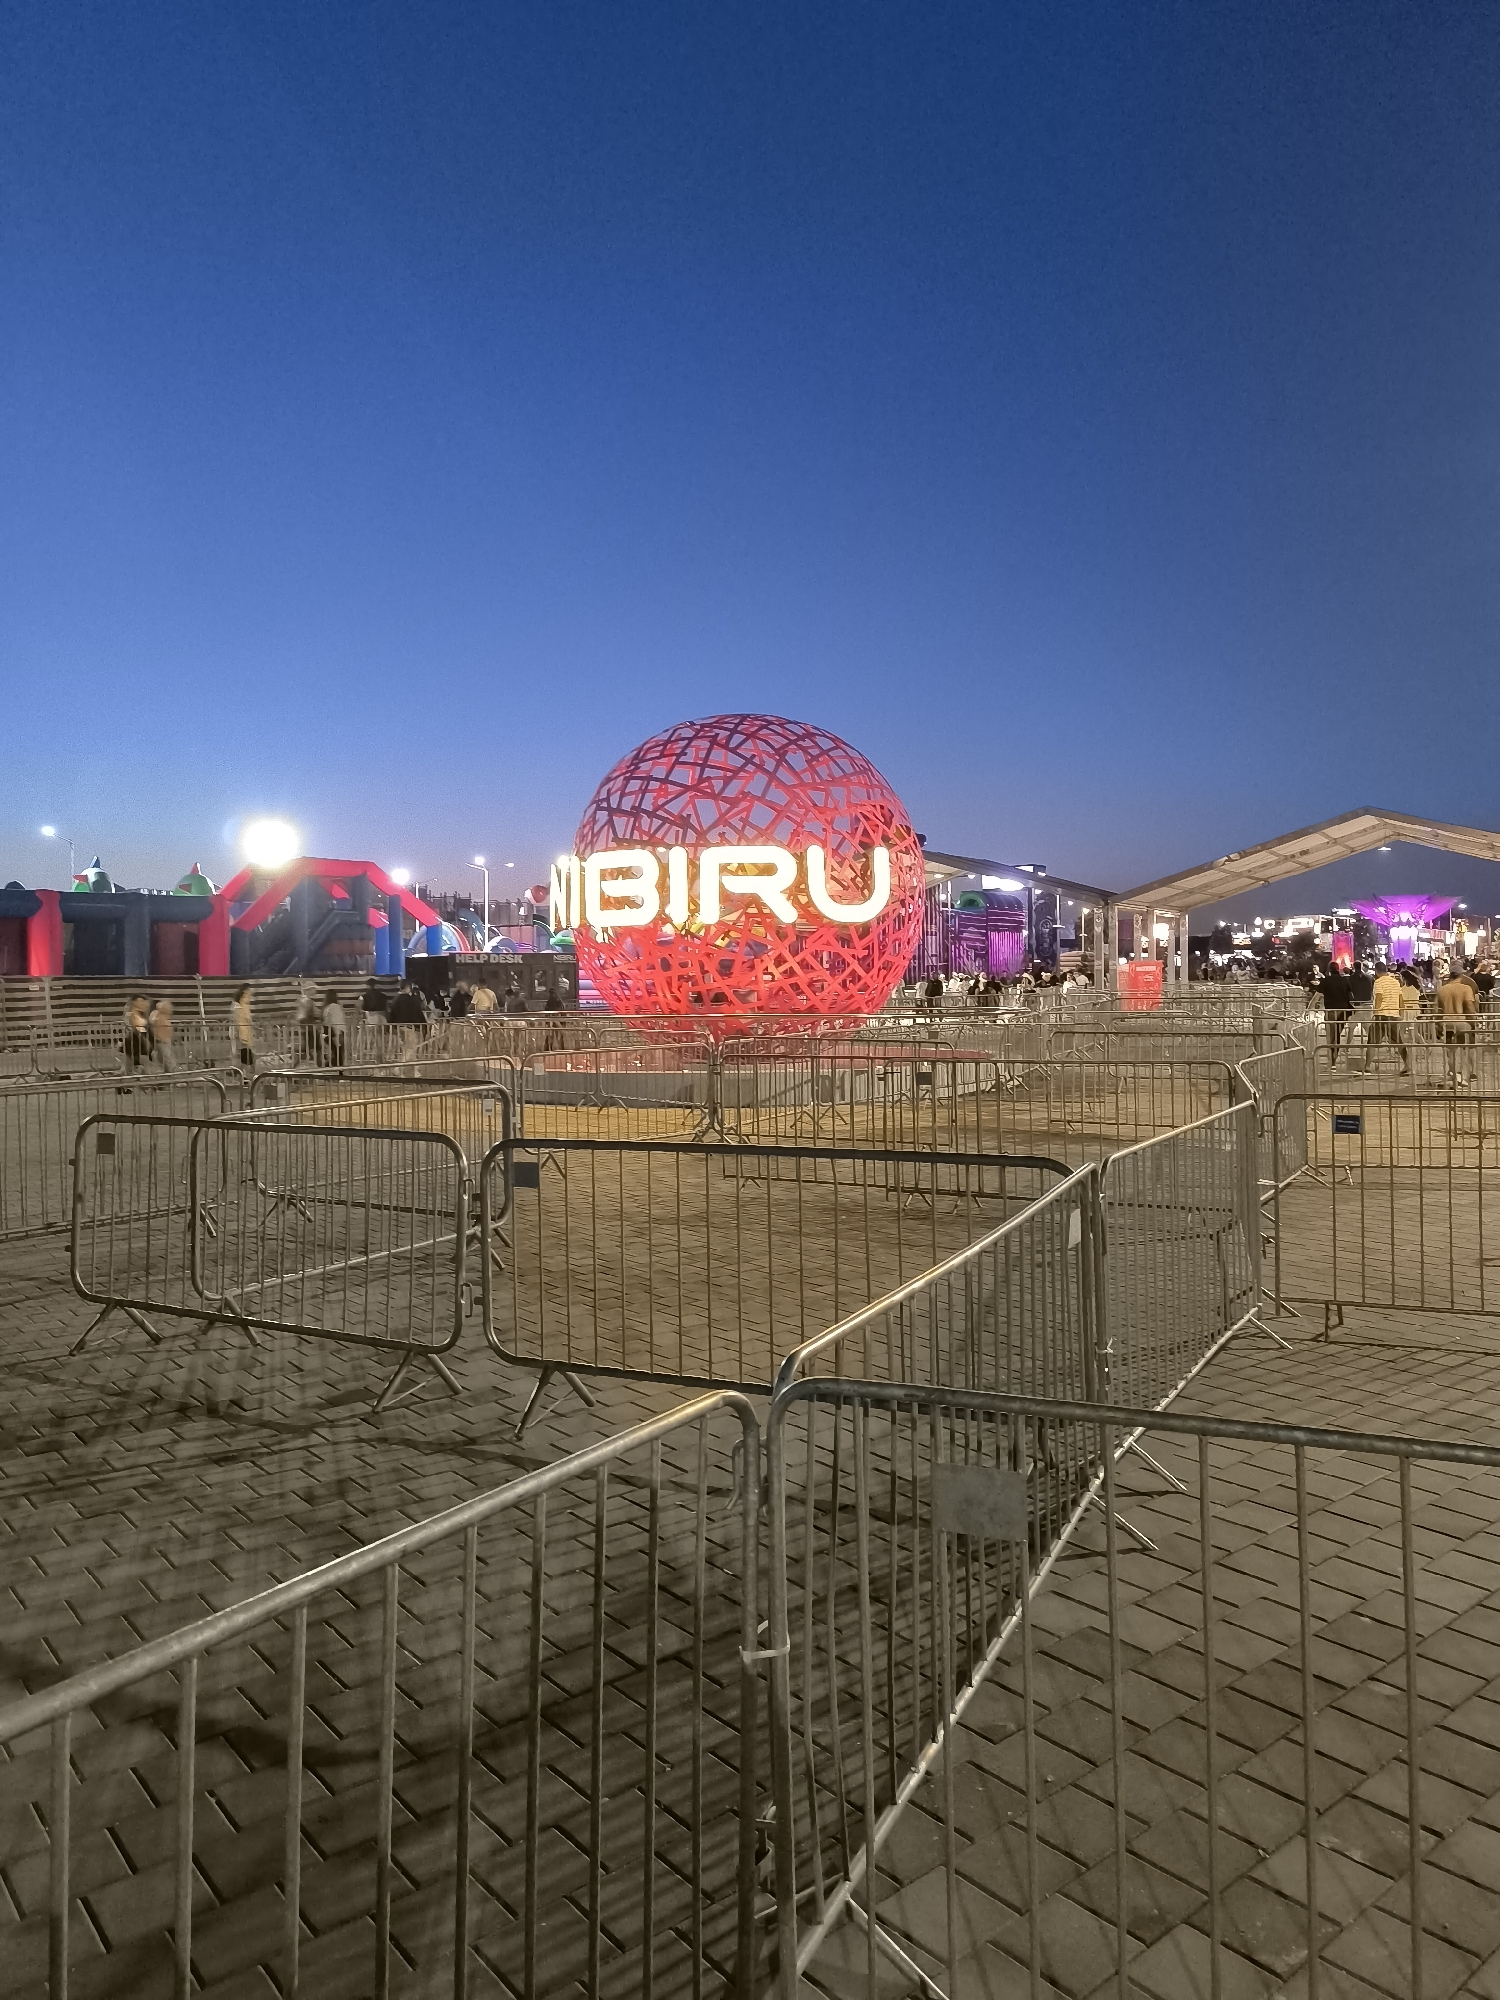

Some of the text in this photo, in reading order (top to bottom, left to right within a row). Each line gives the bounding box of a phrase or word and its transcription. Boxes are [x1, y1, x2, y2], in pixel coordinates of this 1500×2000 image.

[549, 845, 891, 931] NIBIRU
[455, 953, 523, 964] HELP DESK
